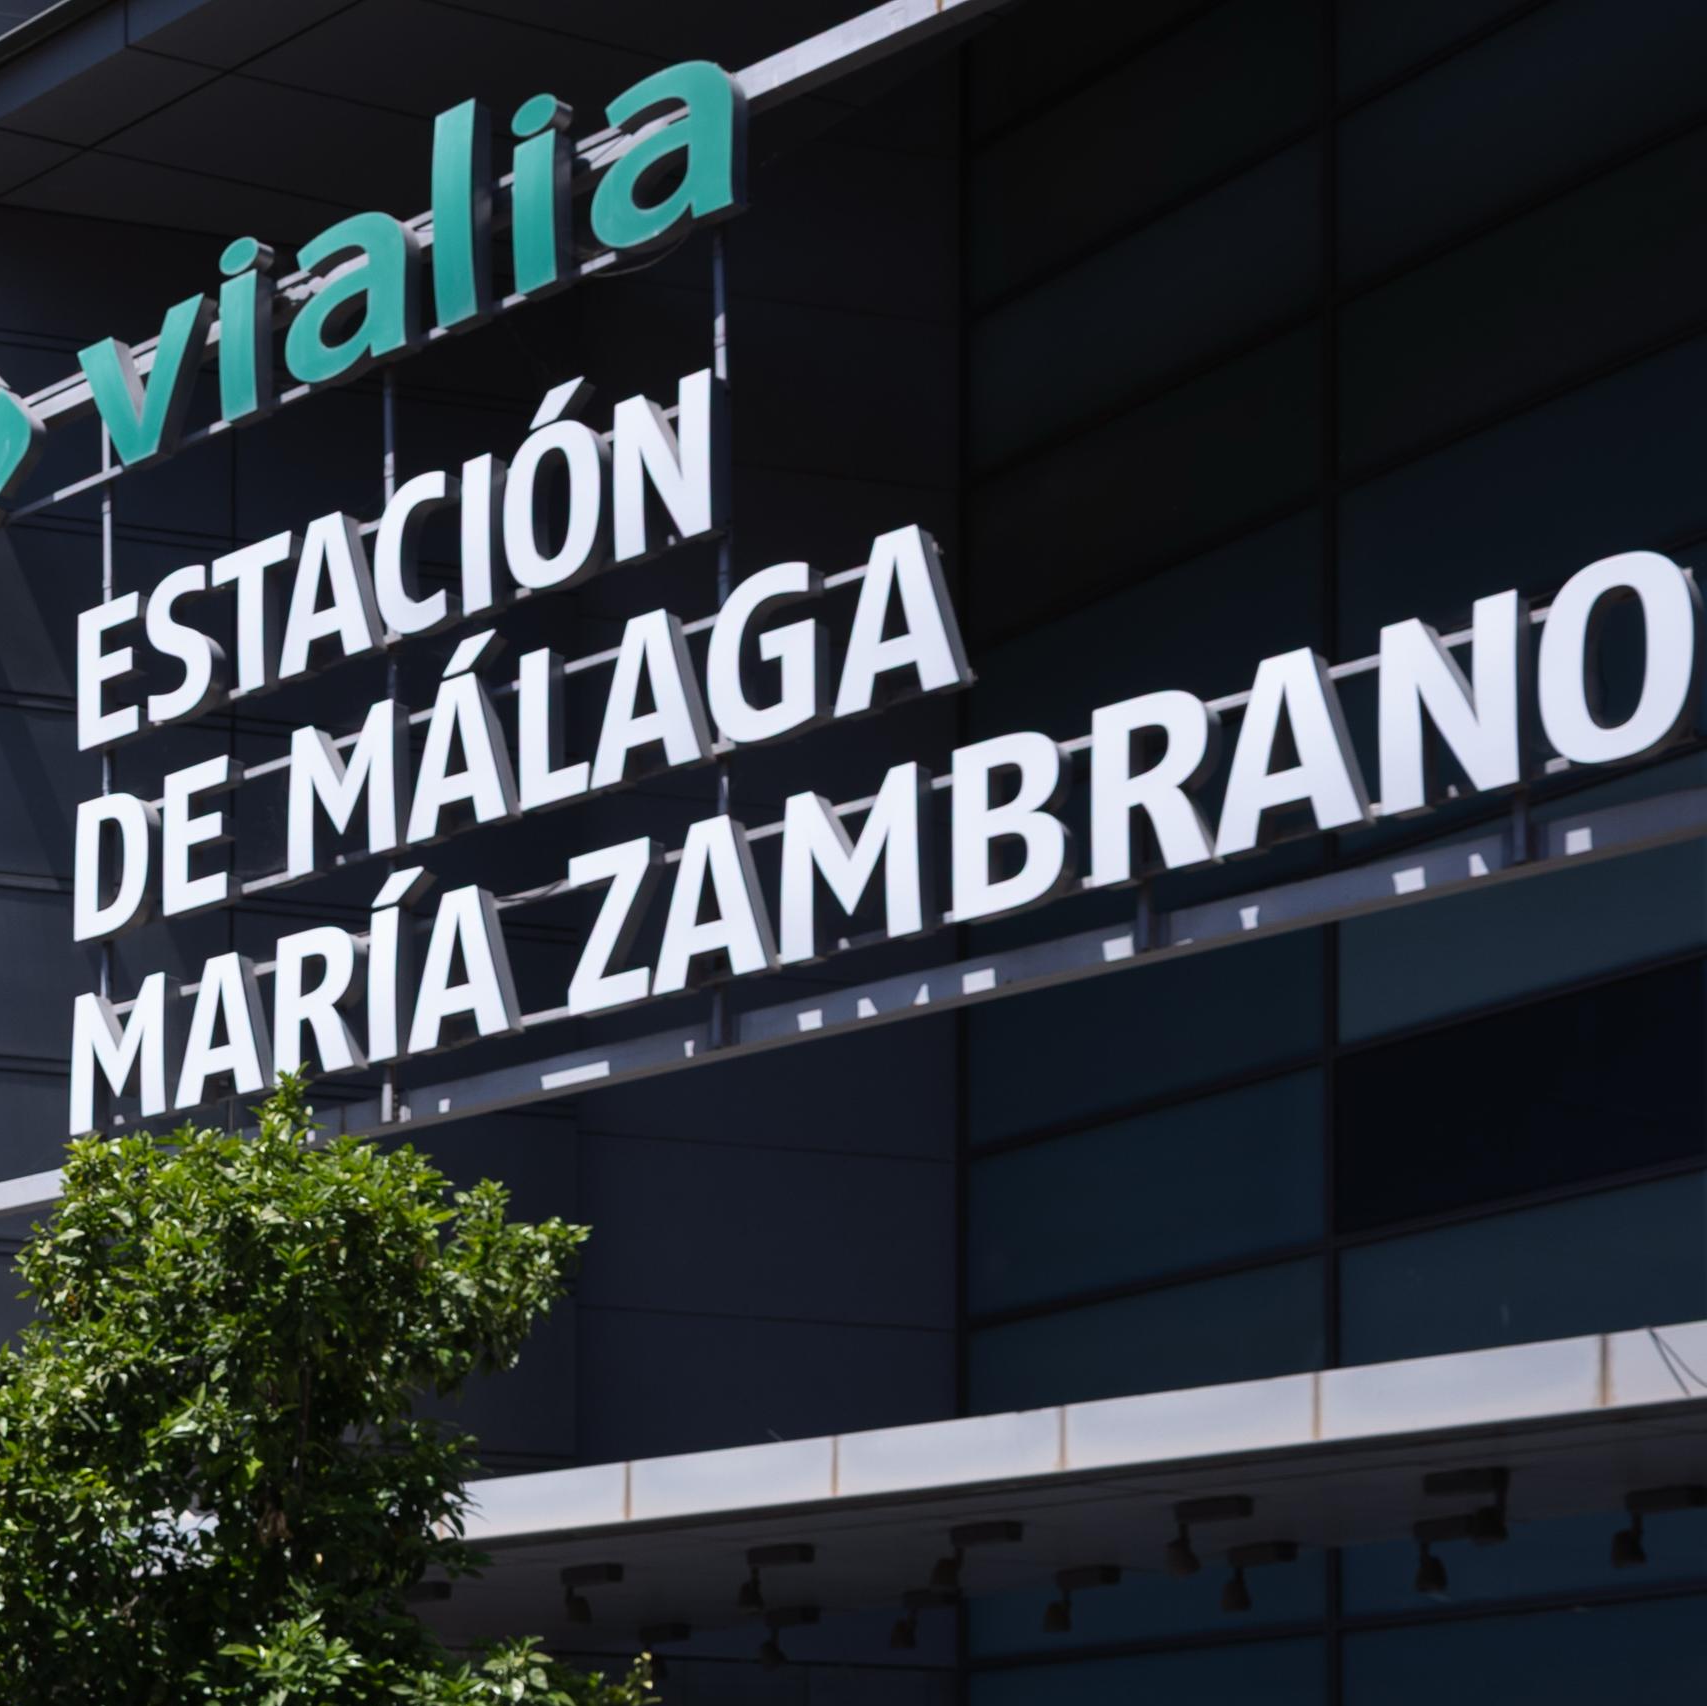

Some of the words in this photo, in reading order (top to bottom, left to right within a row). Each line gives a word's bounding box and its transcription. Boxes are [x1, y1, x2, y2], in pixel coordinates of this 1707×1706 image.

[78, 60, 747, 465] vialia
[75, 753, 239, 944] DE
[288, 524, 973, 879] MÁLAGA
[77, 369, 719, 751] ESTACIÓN
[70, 868, 520, 1136] MARÍA
[566, 549, 1696, 1015] ZAMBRANO
